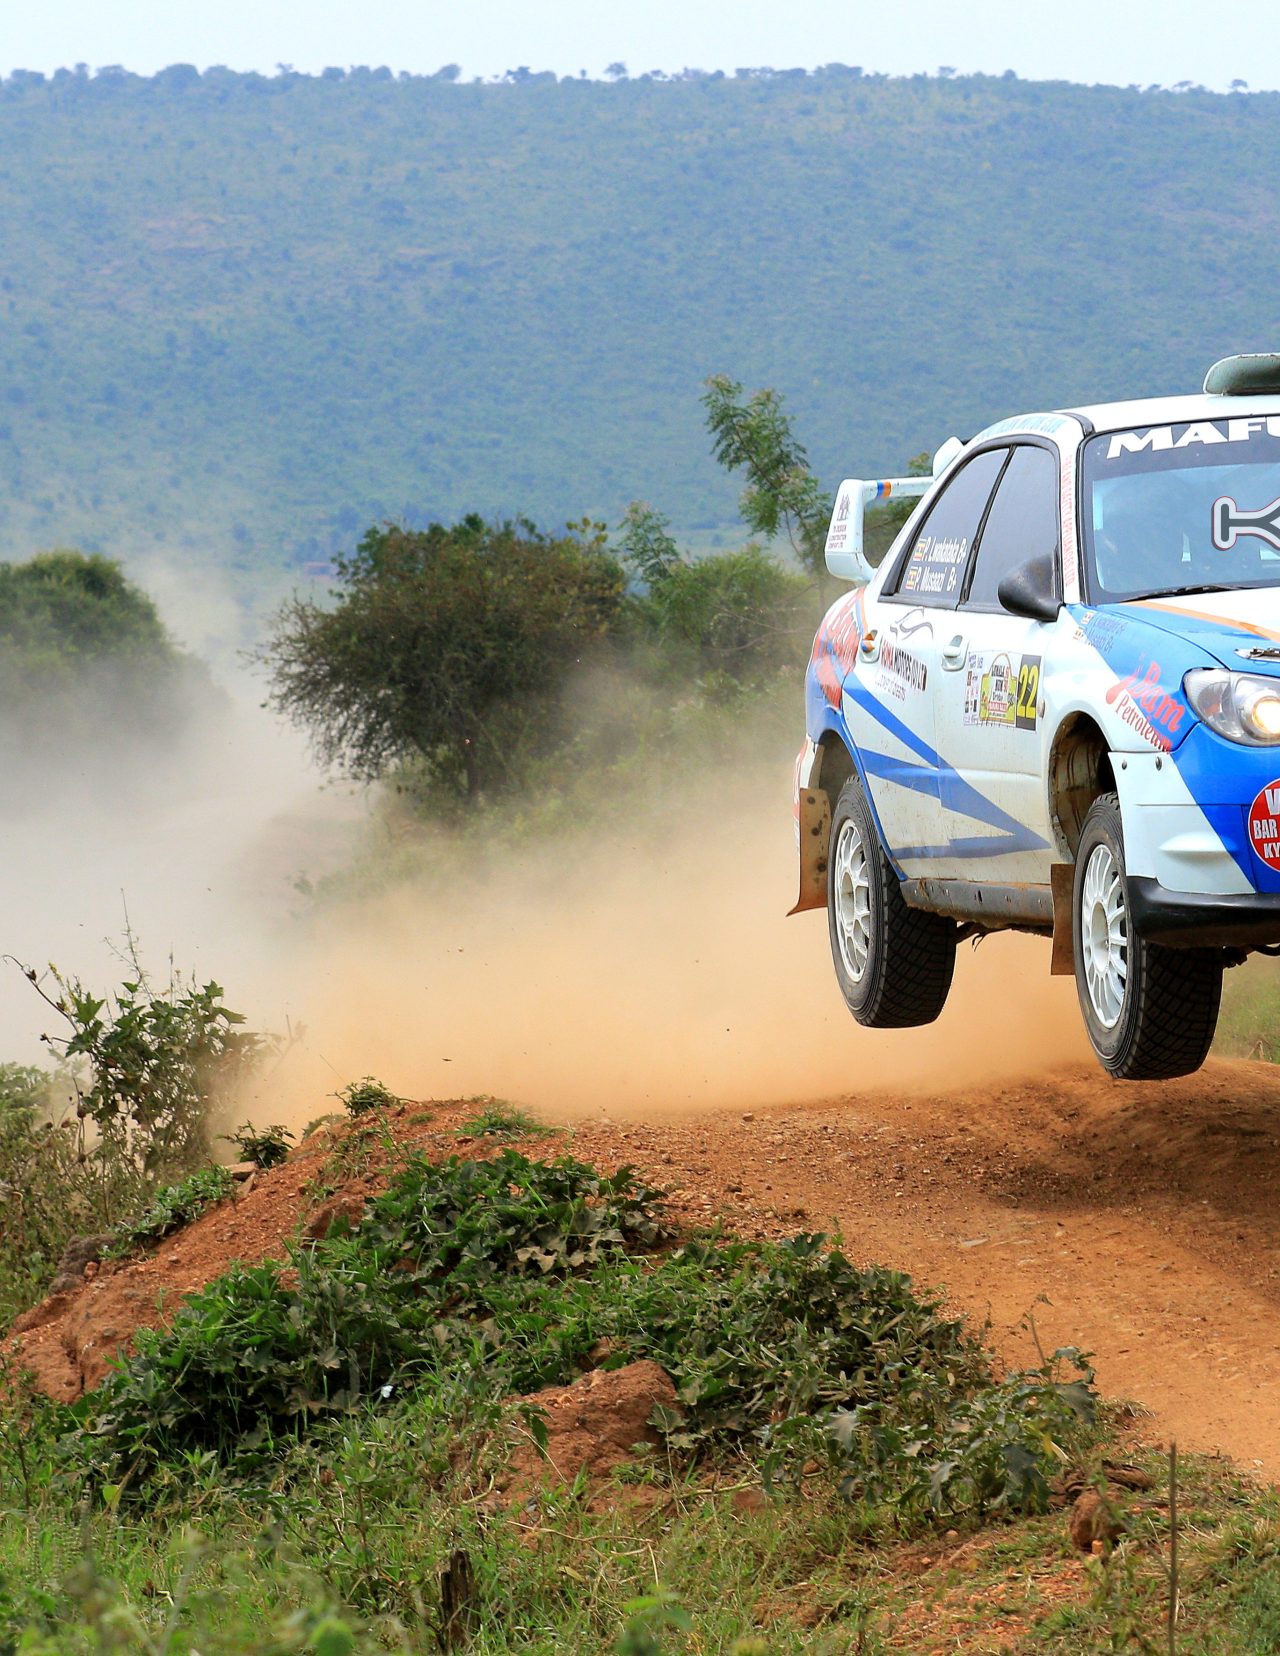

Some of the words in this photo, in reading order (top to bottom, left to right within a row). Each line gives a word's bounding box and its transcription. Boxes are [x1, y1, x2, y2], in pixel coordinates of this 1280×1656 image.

[1017, 664, 1039, 719] 22
[1115, 694, 1172, 754] Petroleum
[1252, 818, 1278, 839] BAR
